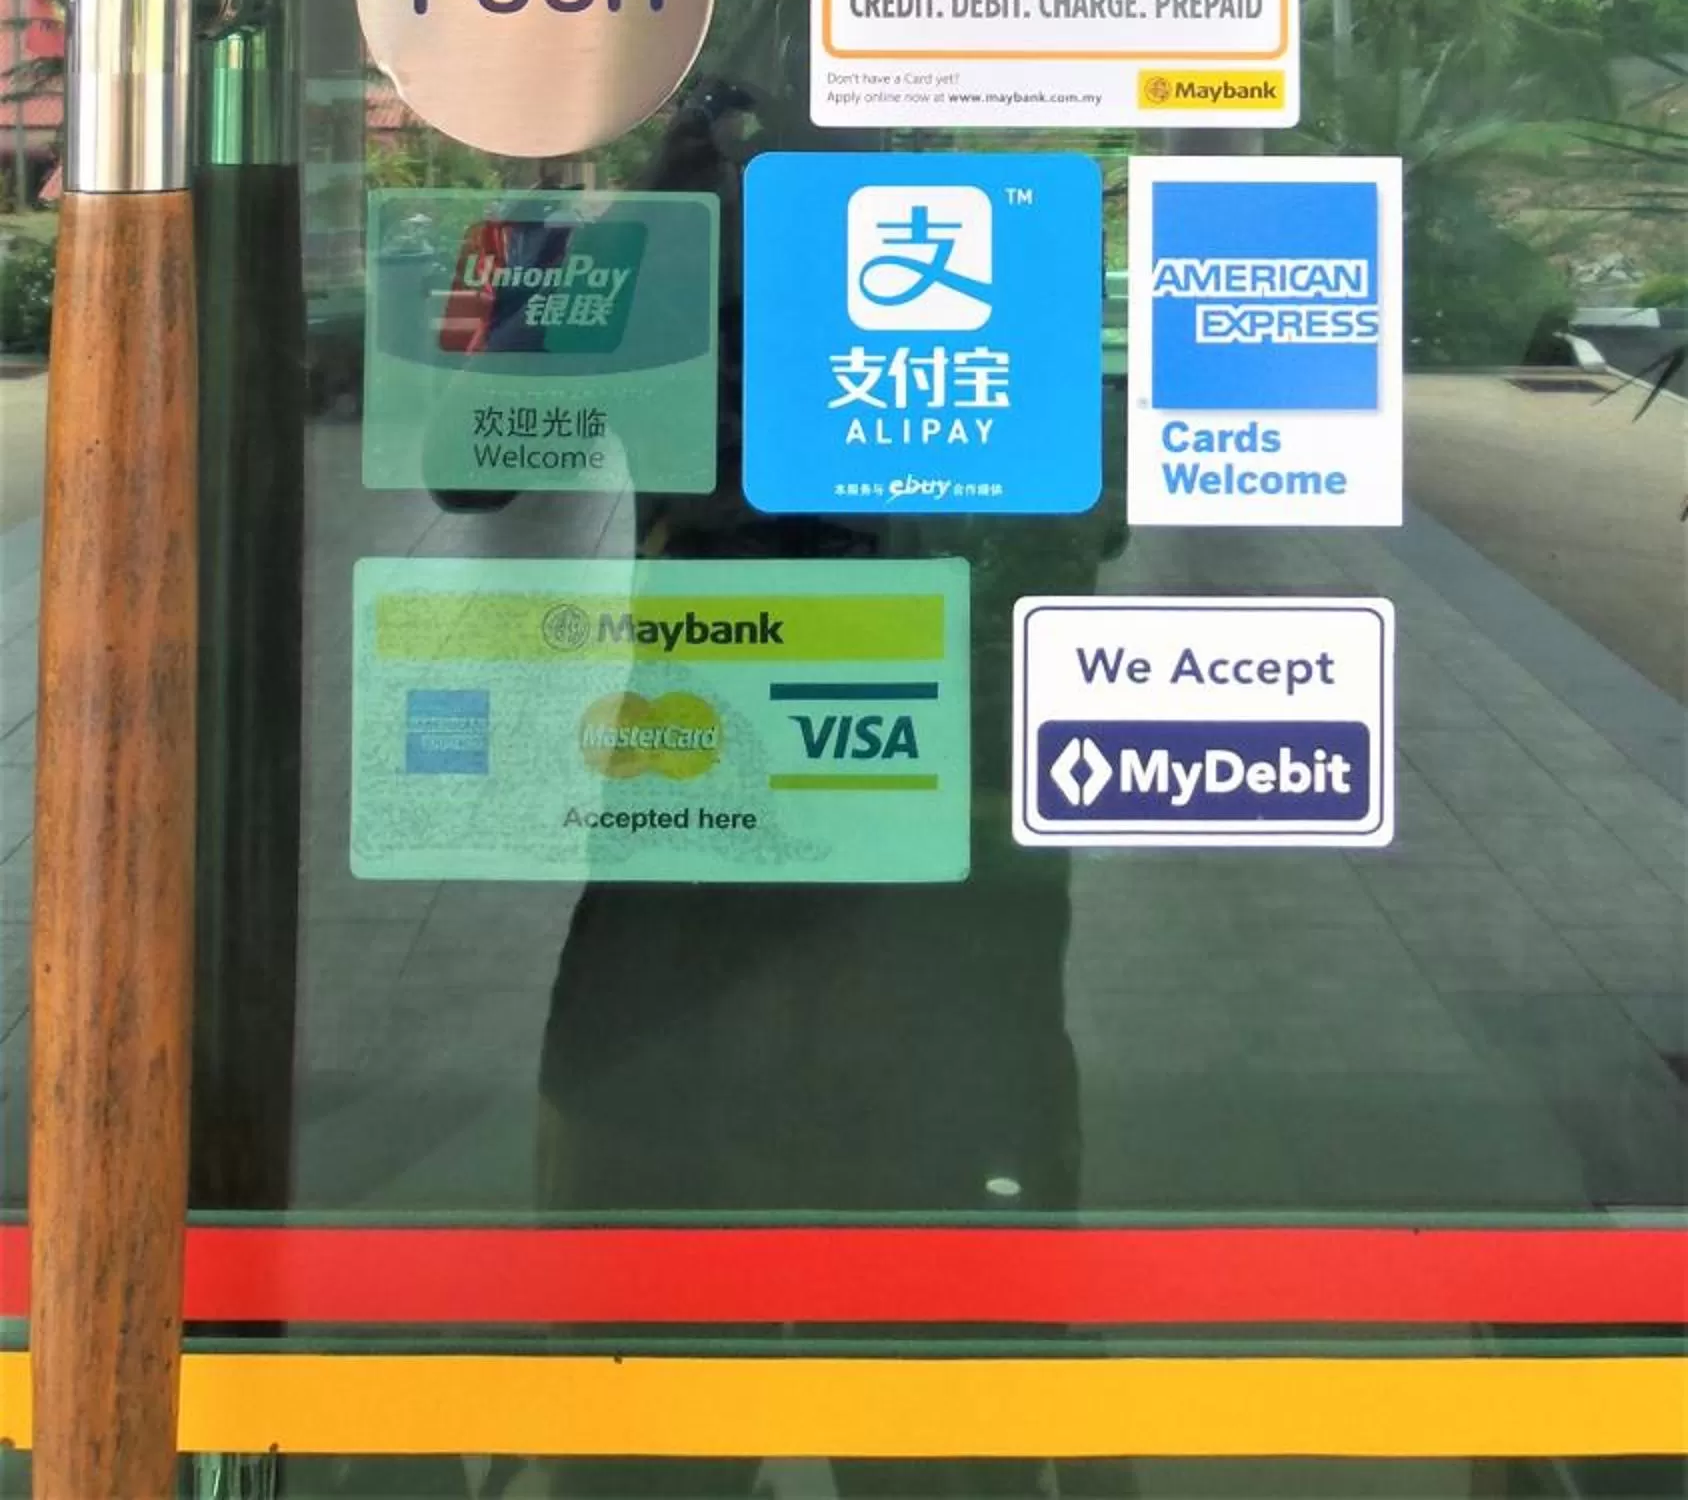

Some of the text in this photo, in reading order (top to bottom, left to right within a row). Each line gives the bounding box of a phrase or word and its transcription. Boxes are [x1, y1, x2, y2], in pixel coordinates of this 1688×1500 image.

[827, 72, 960, 88] Don't have a Card yet?
[1175, 80, 1277, 102] Maybank
[827, 91, 1101, 105] Apply online now at www.maybank.com.my
[1005, 187, 1033, 205] TM
[463, 254, 631, 300] UnionPay
[1153, 263, 1364, 293] AMERICAN
[525, 293, 614, 327] 银联
[1201, 309, 1379, 338] EXPRESS
[827, 345, 1011, 409] 支付宝
[473, 405, 608, 438] 欢迎光临
[846, 418, 994, 445] ALIPAY
[1160, 419, 1282, 454] Cards
[473, 443, 606, 470] Welcome
[1160, 462, 1348, 495] Welcome
[596, 611, 785, 653] Maybank
[1076, 646, 1336, 697] We Accept
[582, 724, 719, 752] MasterCard
[787, 713, 920, 761] VISA
[1119, 746, 1352, 808] MyDebit
[562, 806, 758, 836] Accepted here
